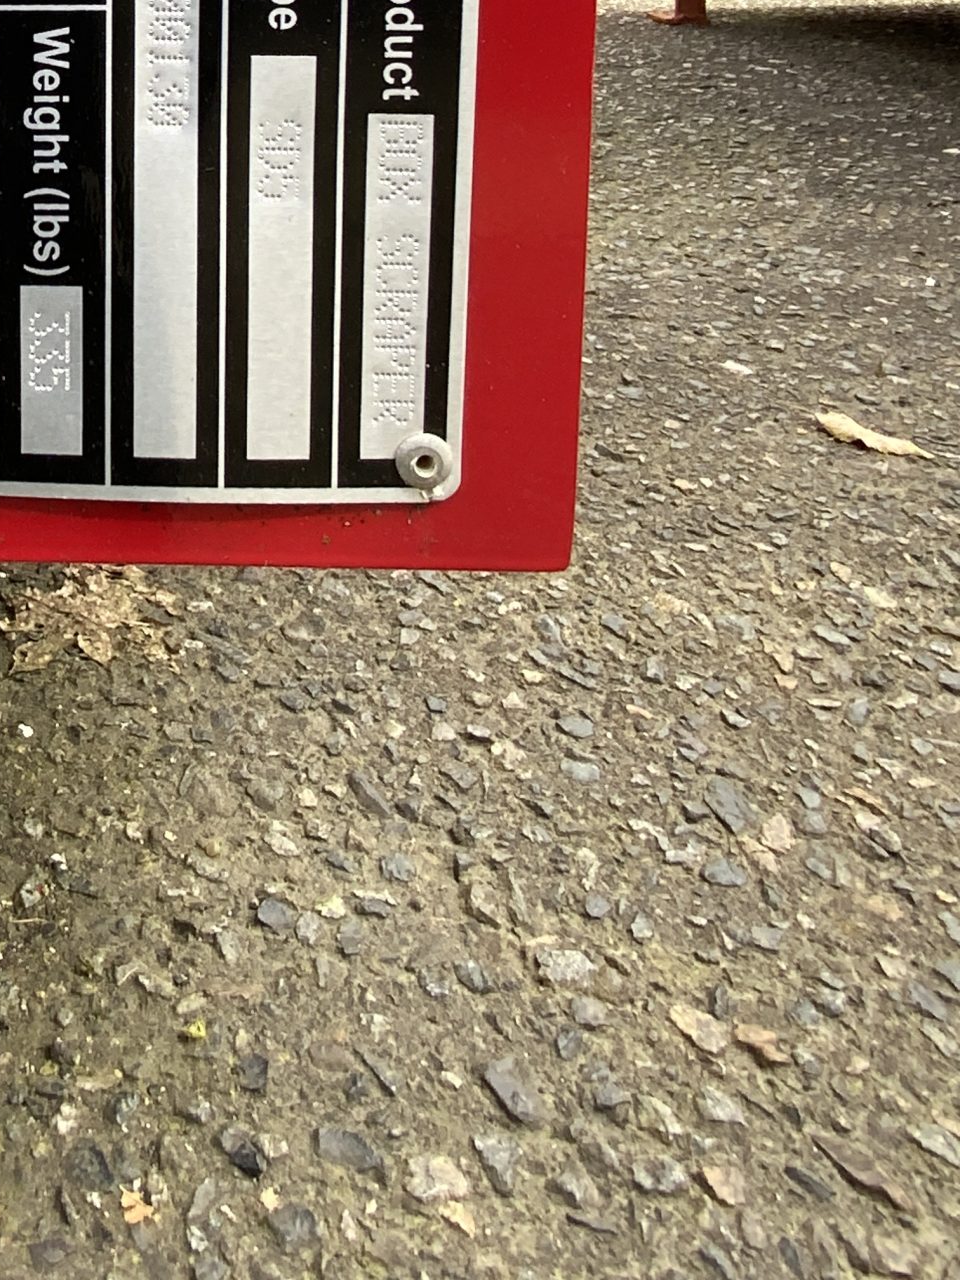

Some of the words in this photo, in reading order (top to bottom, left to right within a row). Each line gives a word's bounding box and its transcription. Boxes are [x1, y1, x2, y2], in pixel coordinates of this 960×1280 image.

[24, 27, 69, 173] Weight
[257, 119, 303, 200] SD5
[377, 119, 425, 205] BOX
[24, 188, 69, 275] (lbs)
[28, 310, 71, 392] 335
[372, 233, 420, 426] SCRAPER
